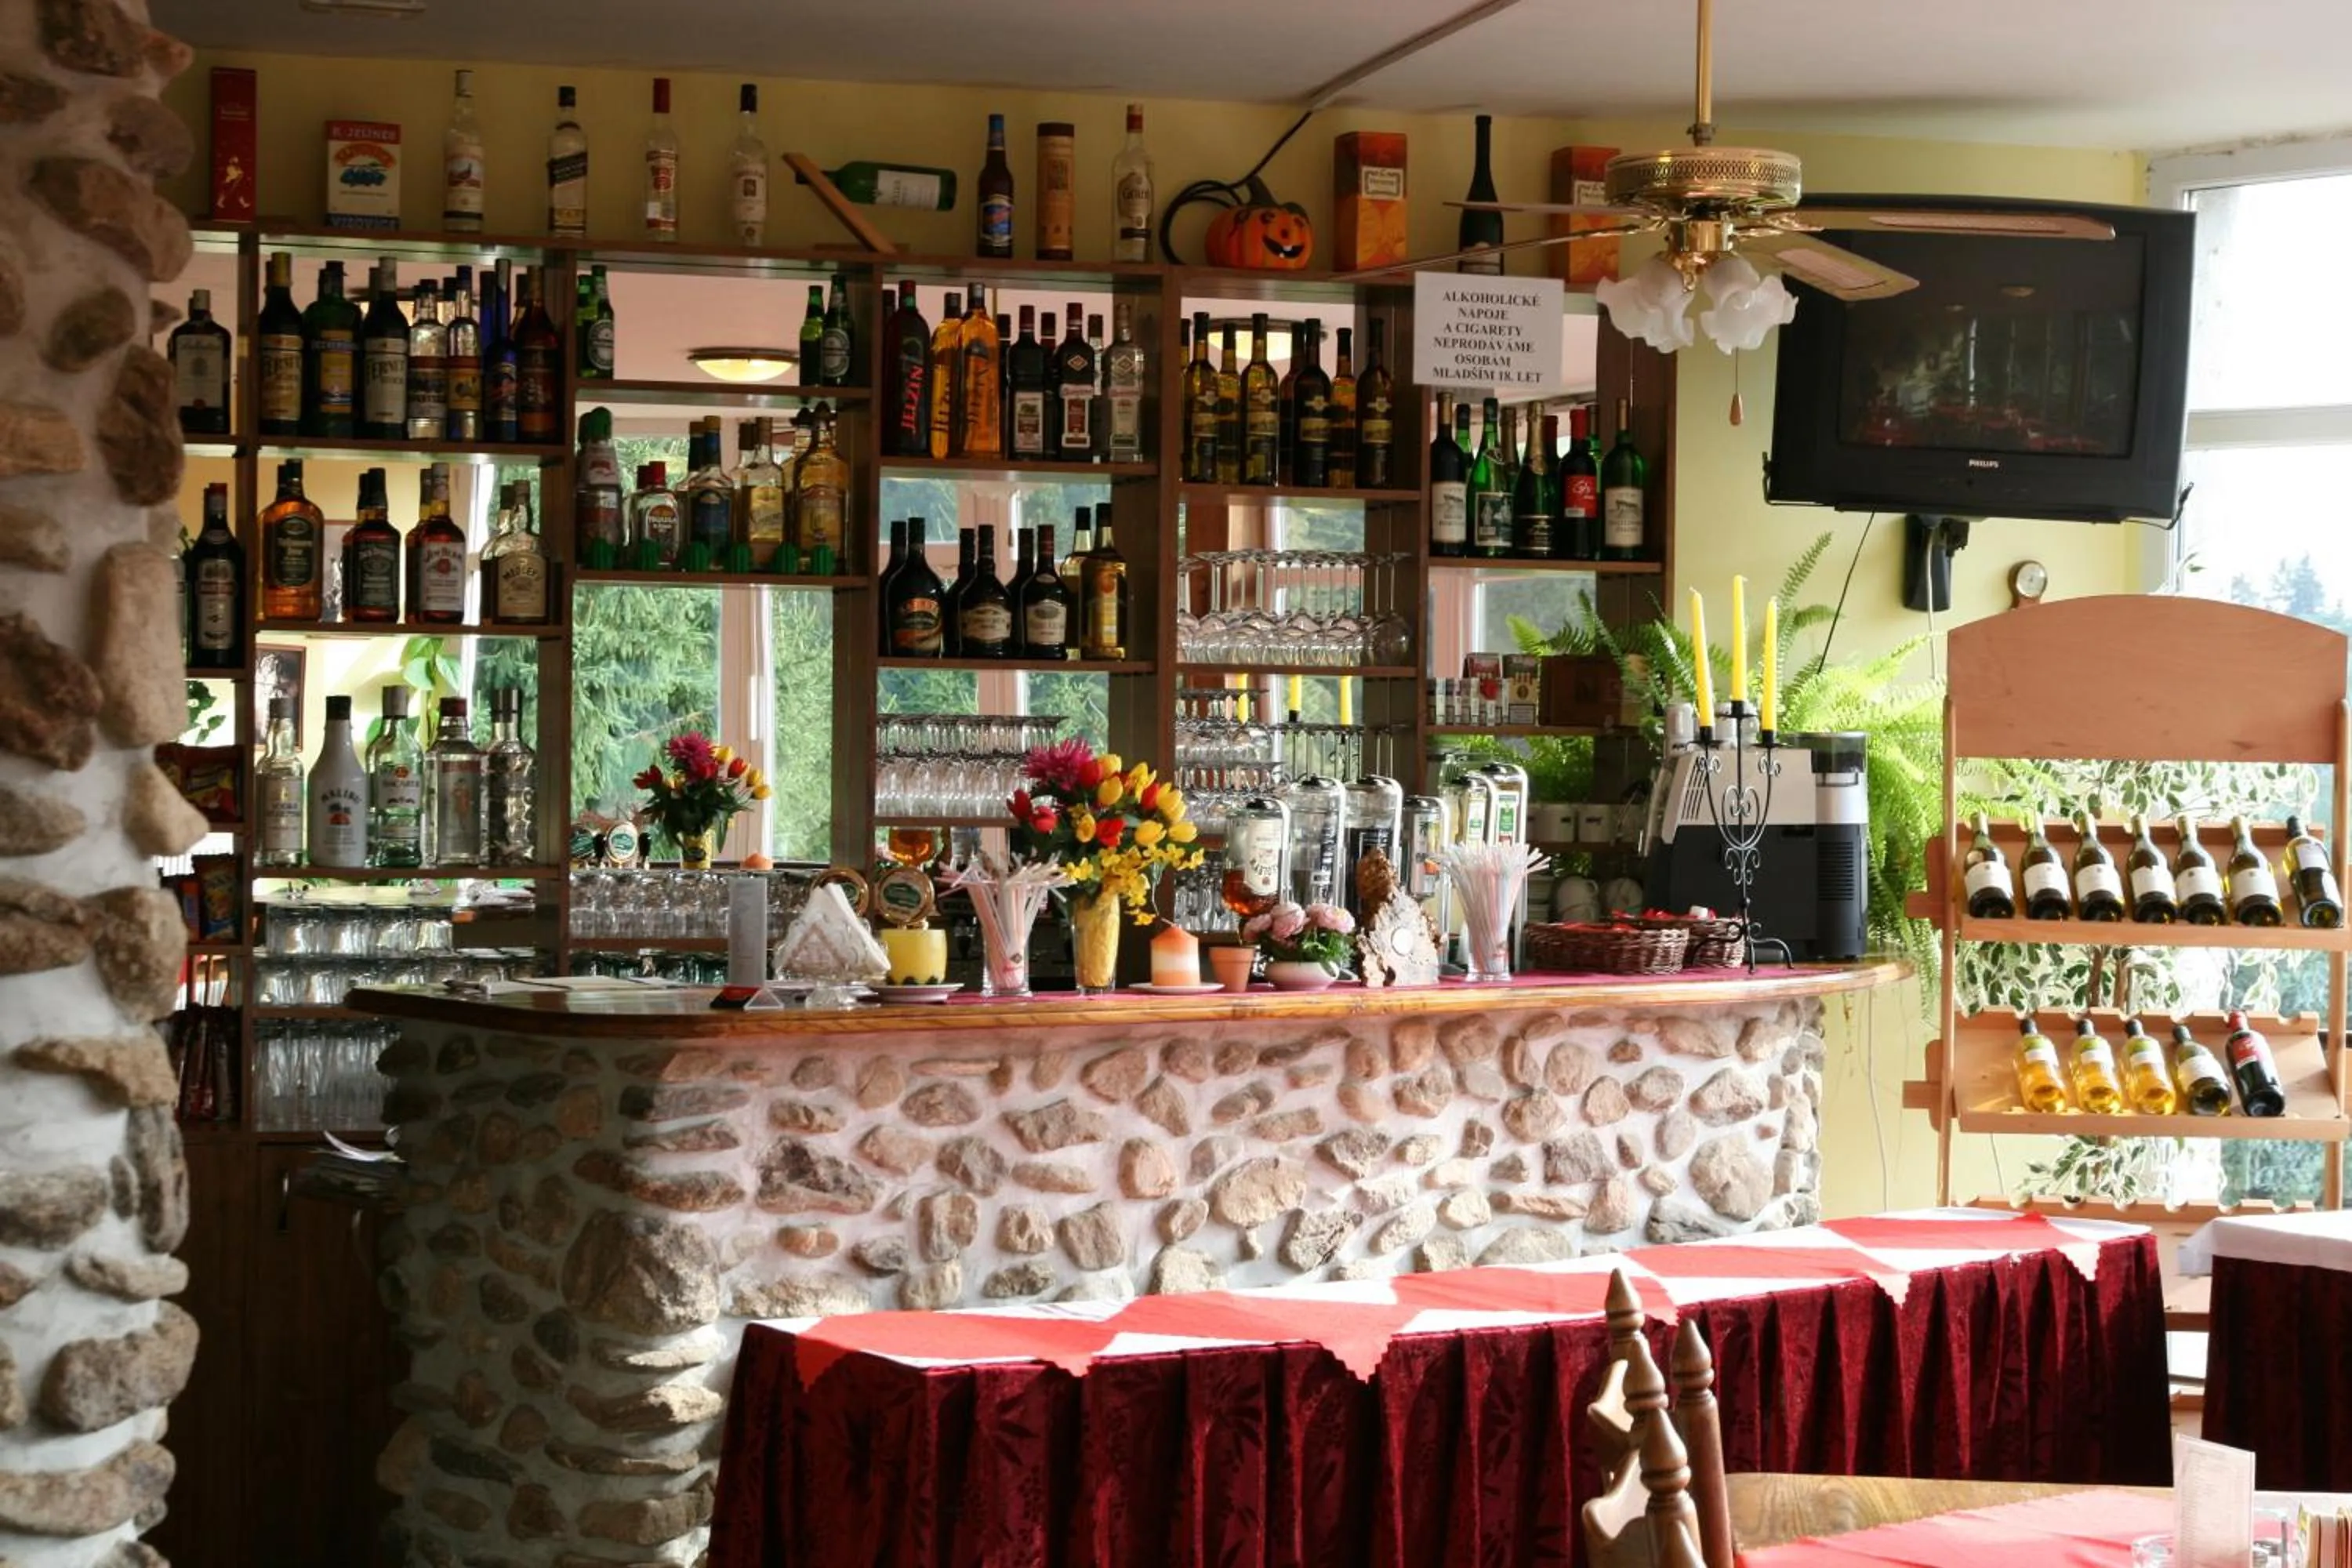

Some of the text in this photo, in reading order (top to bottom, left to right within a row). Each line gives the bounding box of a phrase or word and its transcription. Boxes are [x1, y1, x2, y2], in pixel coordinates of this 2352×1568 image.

[1444, 322, 1523, 336] A CIGARETY
[1517, 372, 1544, 383] LET
[901, 365, 924, 435] JELZIN
[1969, 459, 1999, 469] PHILIPS
